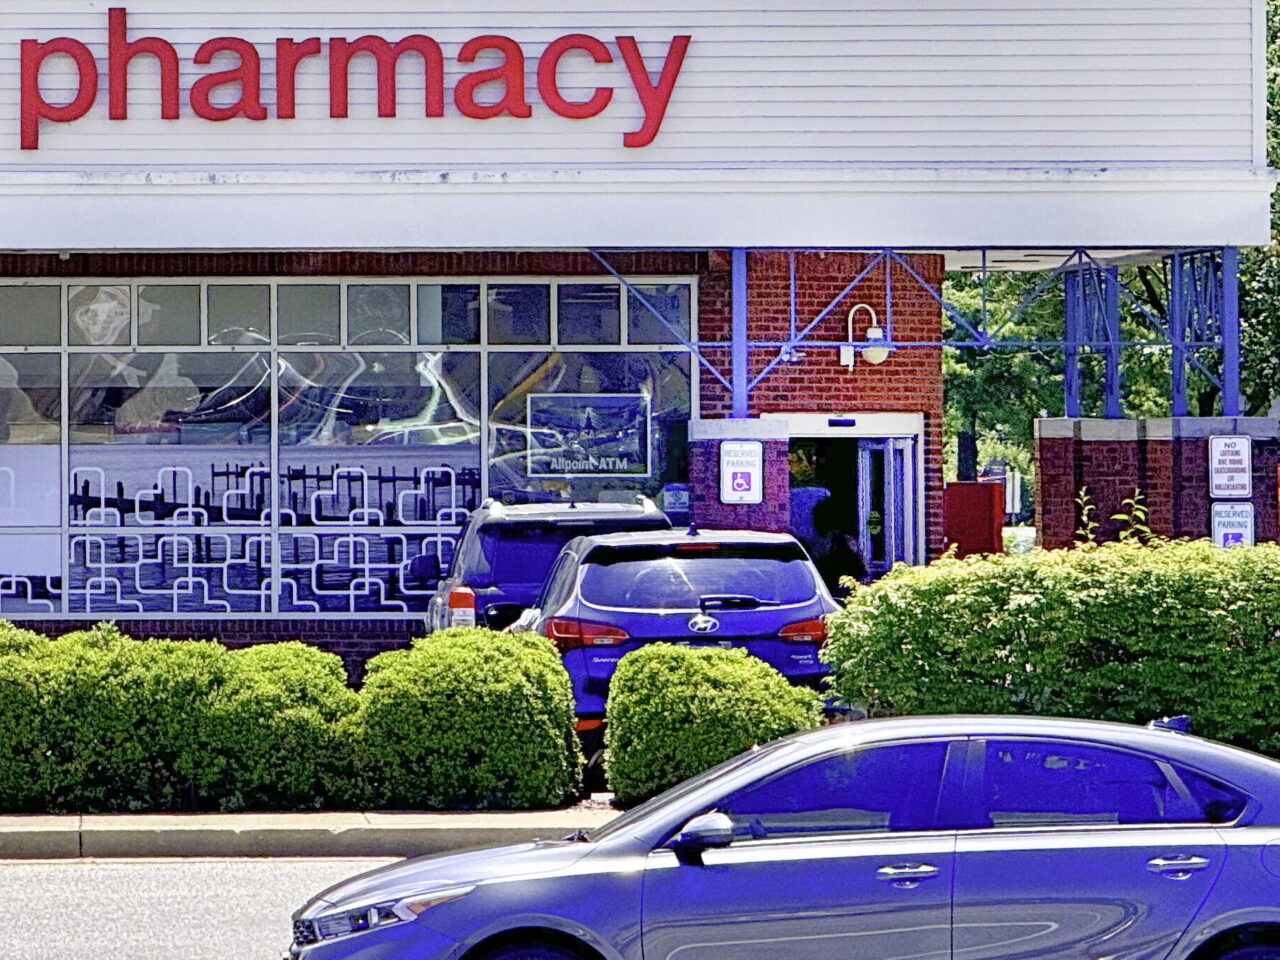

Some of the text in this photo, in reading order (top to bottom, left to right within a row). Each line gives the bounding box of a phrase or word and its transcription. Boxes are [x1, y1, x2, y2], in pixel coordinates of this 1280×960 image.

[19, 7, 691, 150] pharmacy
[723, 449, 759, 458] RESERVED
[550, 457, 628, 472] Allpoint ATM
[726, 459, 757, 468] PARKING
[1214, 511, 1251, 519] RESERVED
[1217, 521, 1248, 529] PARKING
